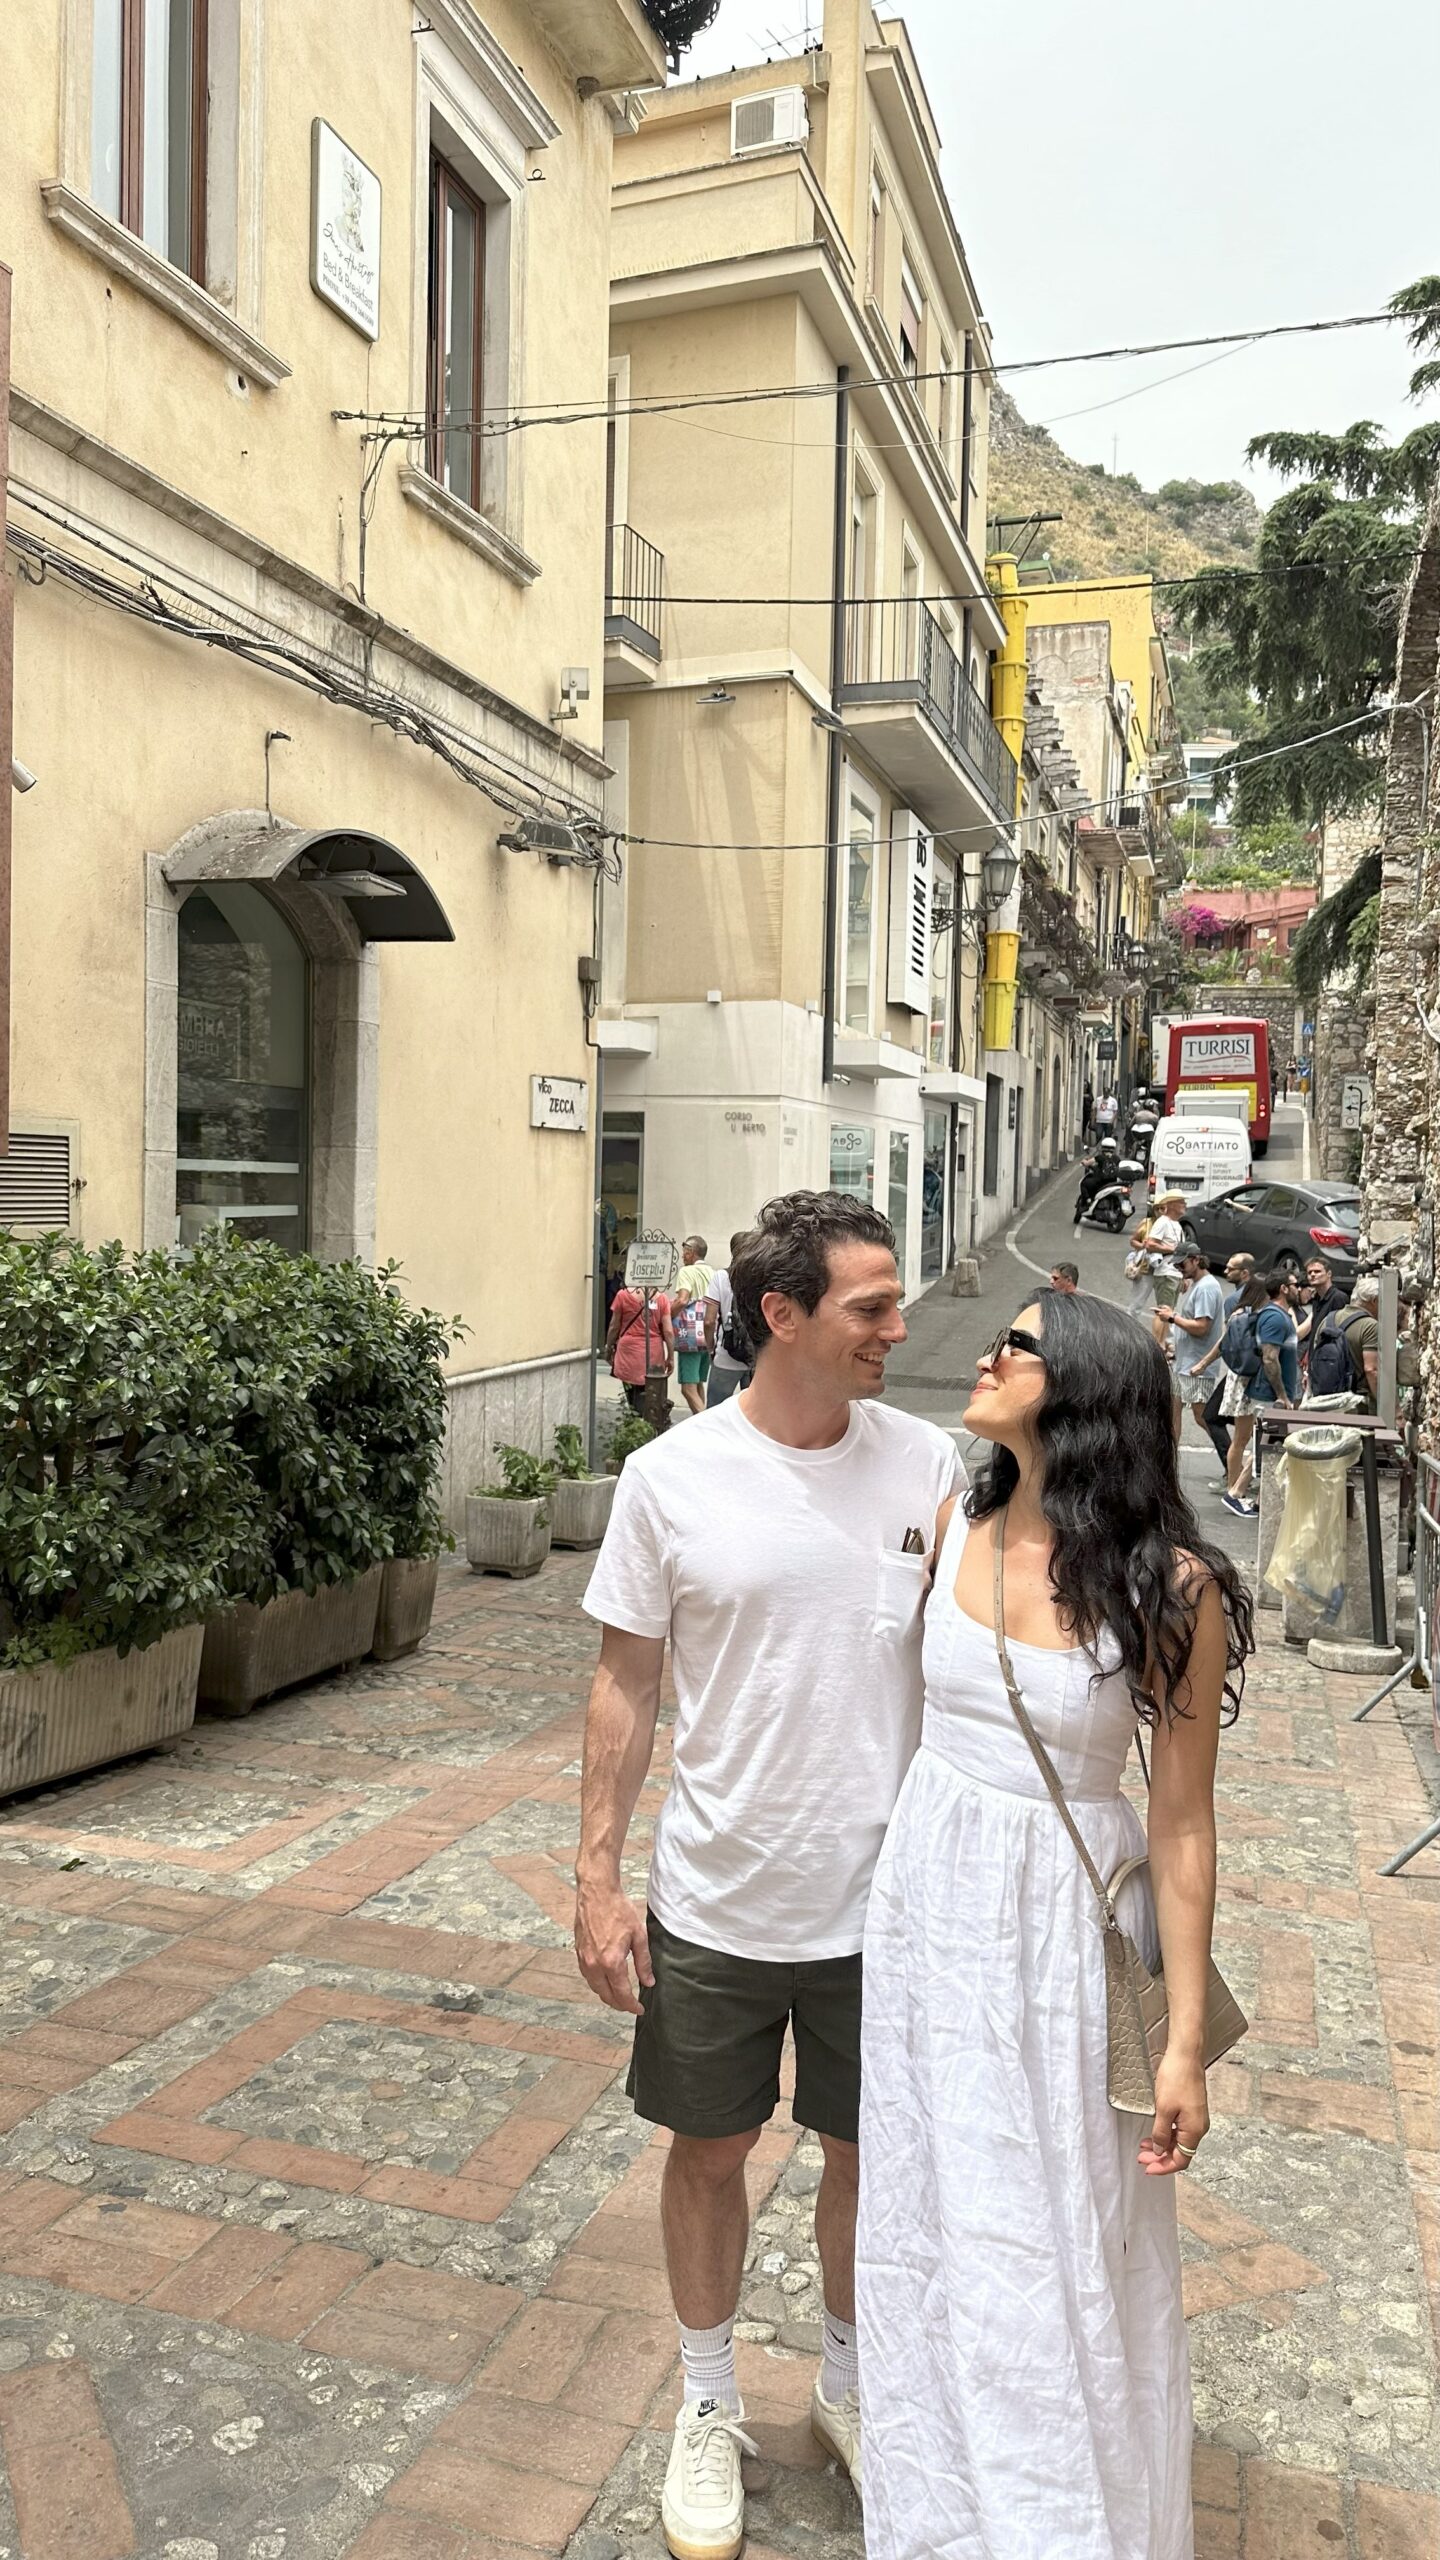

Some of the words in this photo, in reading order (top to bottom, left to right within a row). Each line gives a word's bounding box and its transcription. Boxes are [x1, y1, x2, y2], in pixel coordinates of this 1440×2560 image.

[323, 251, 337, 277] Bed
[338, 266, 343, 282] &
[345, 272, 374, 313] Breakfast
[1185, 1039, 1251, 1057] TURRISI
[549, 1097, 575, 1115] ZECCA
[1185, 1141, 1239, 1151] BATTIATO
[700, 2398, 717, 2410] NIKE
